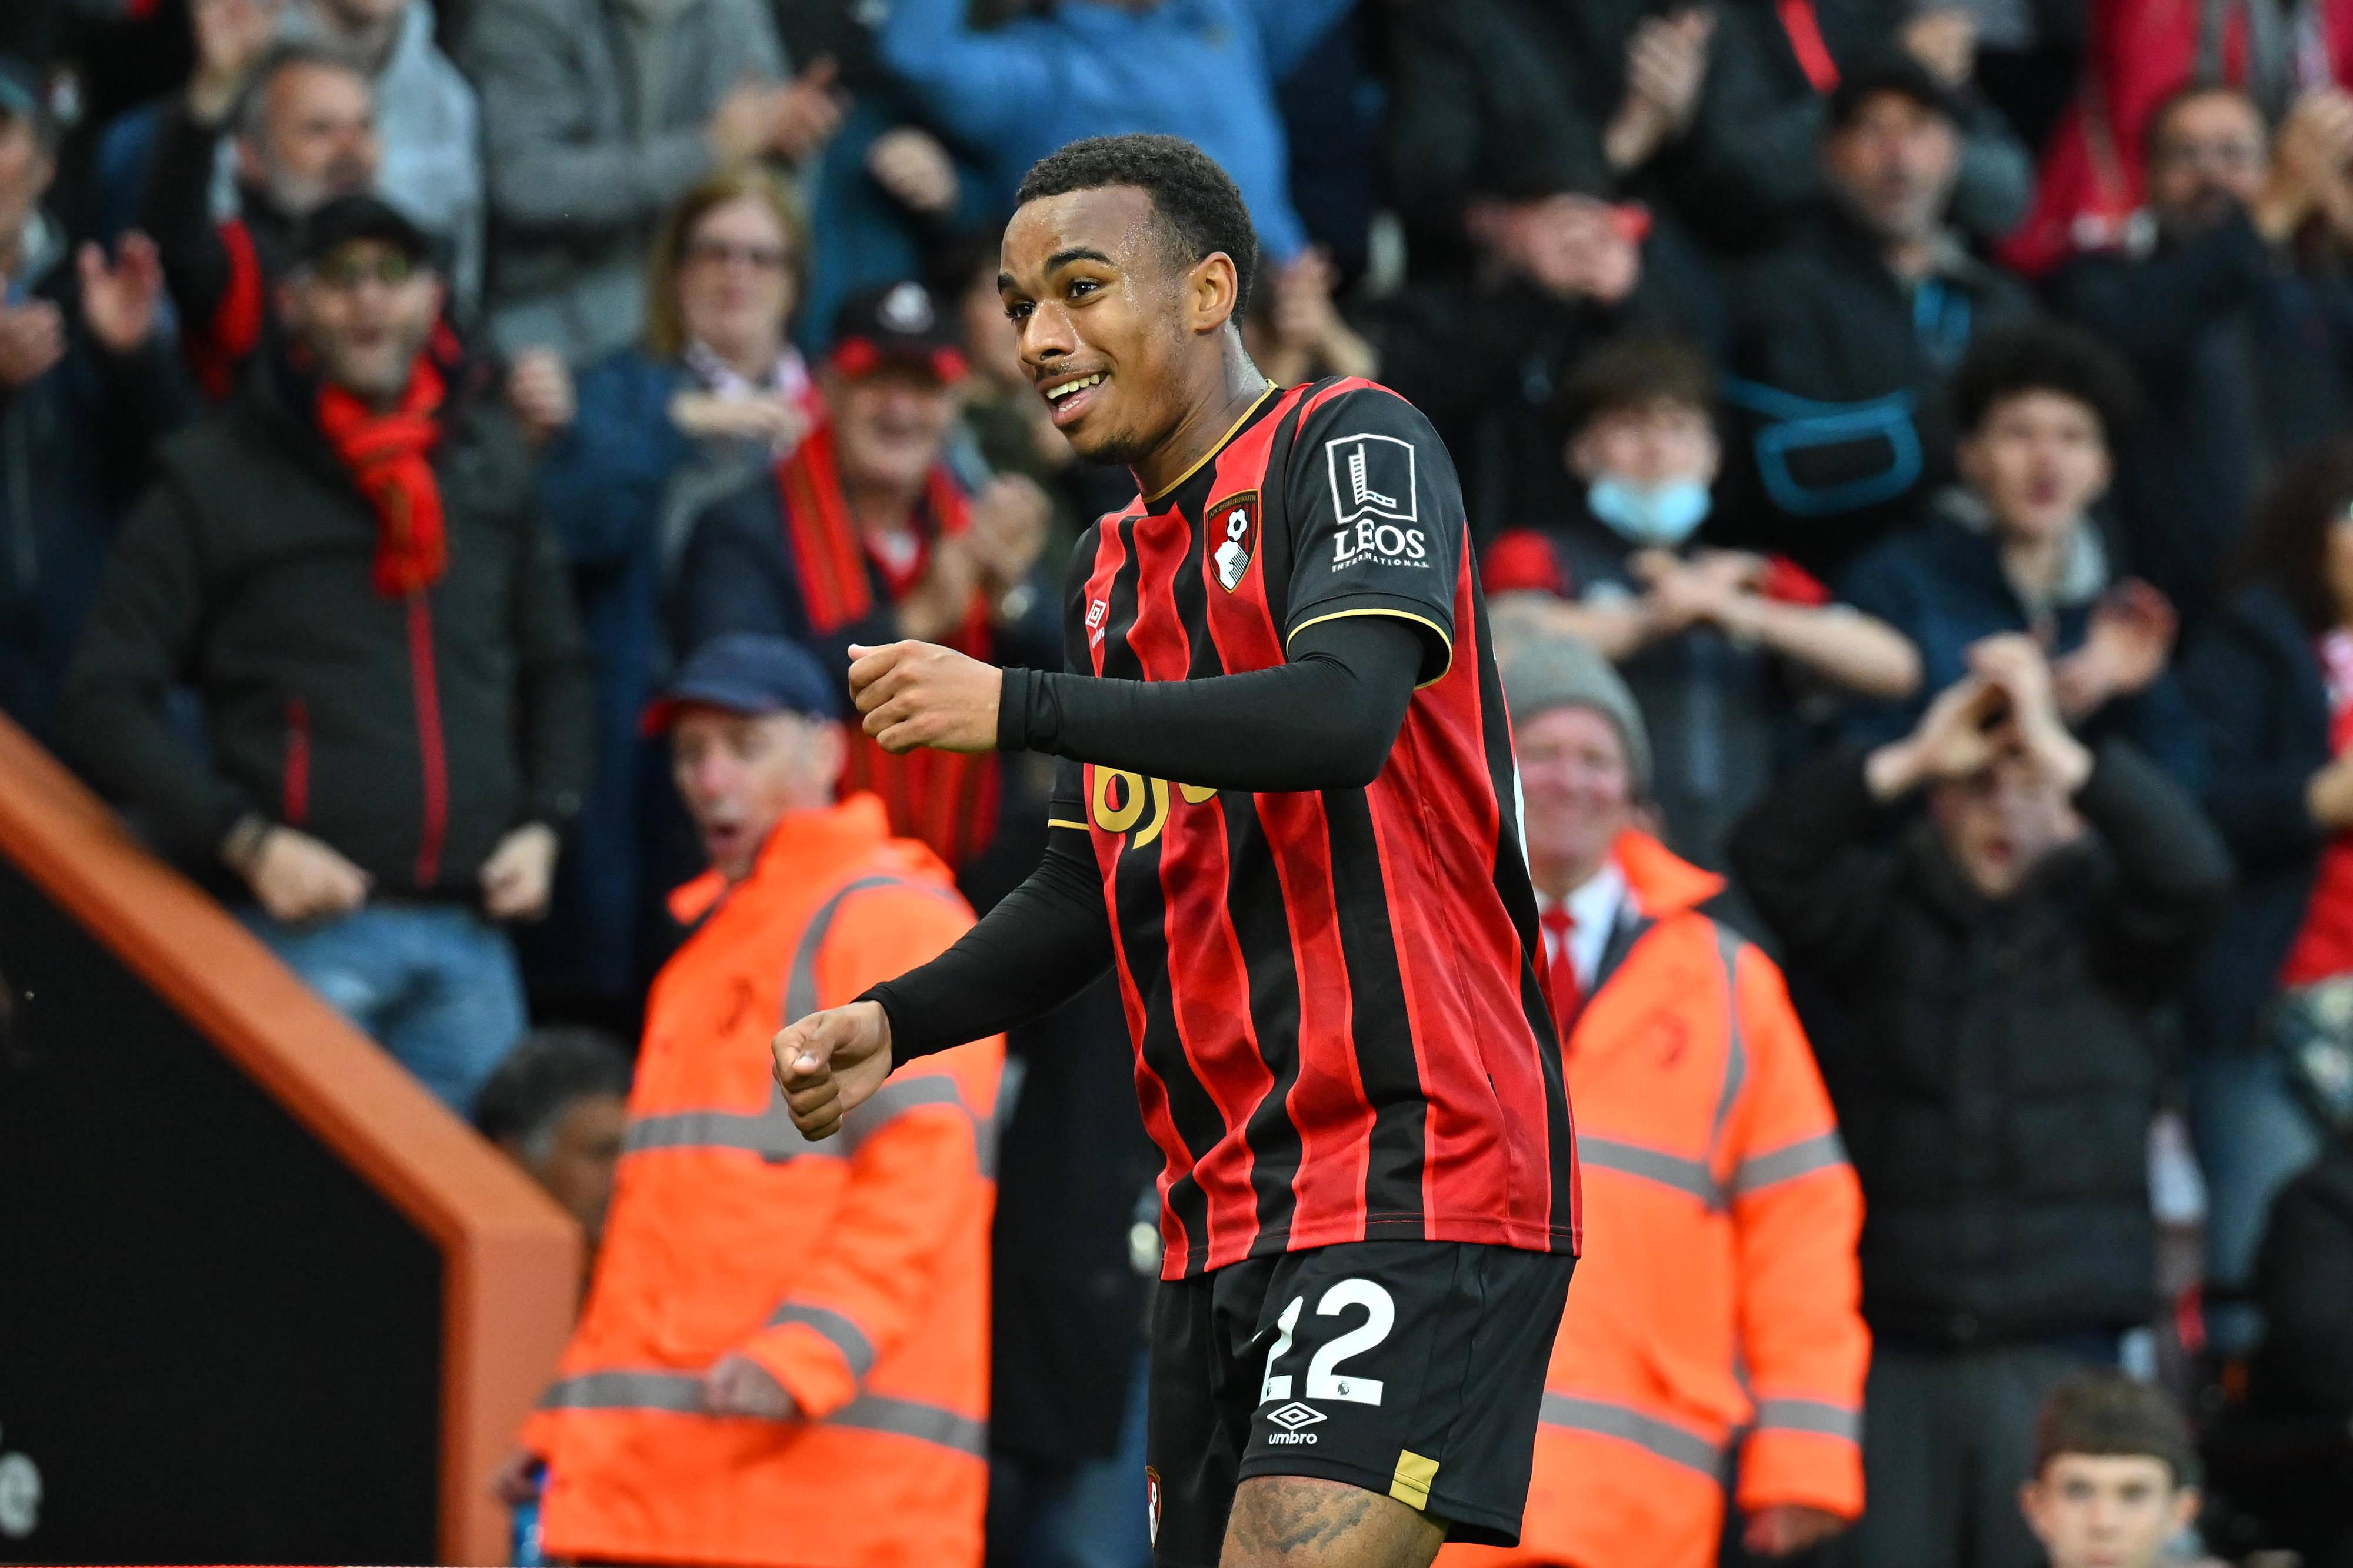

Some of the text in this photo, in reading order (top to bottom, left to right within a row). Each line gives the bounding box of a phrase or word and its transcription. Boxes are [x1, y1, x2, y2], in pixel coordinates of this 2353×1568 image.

[1333, 519, 1425, 562] LEOS
[1331, 551, 1430, 573] INTERNATIONAL
[1268, 1430, 1318, 1445] umbro
